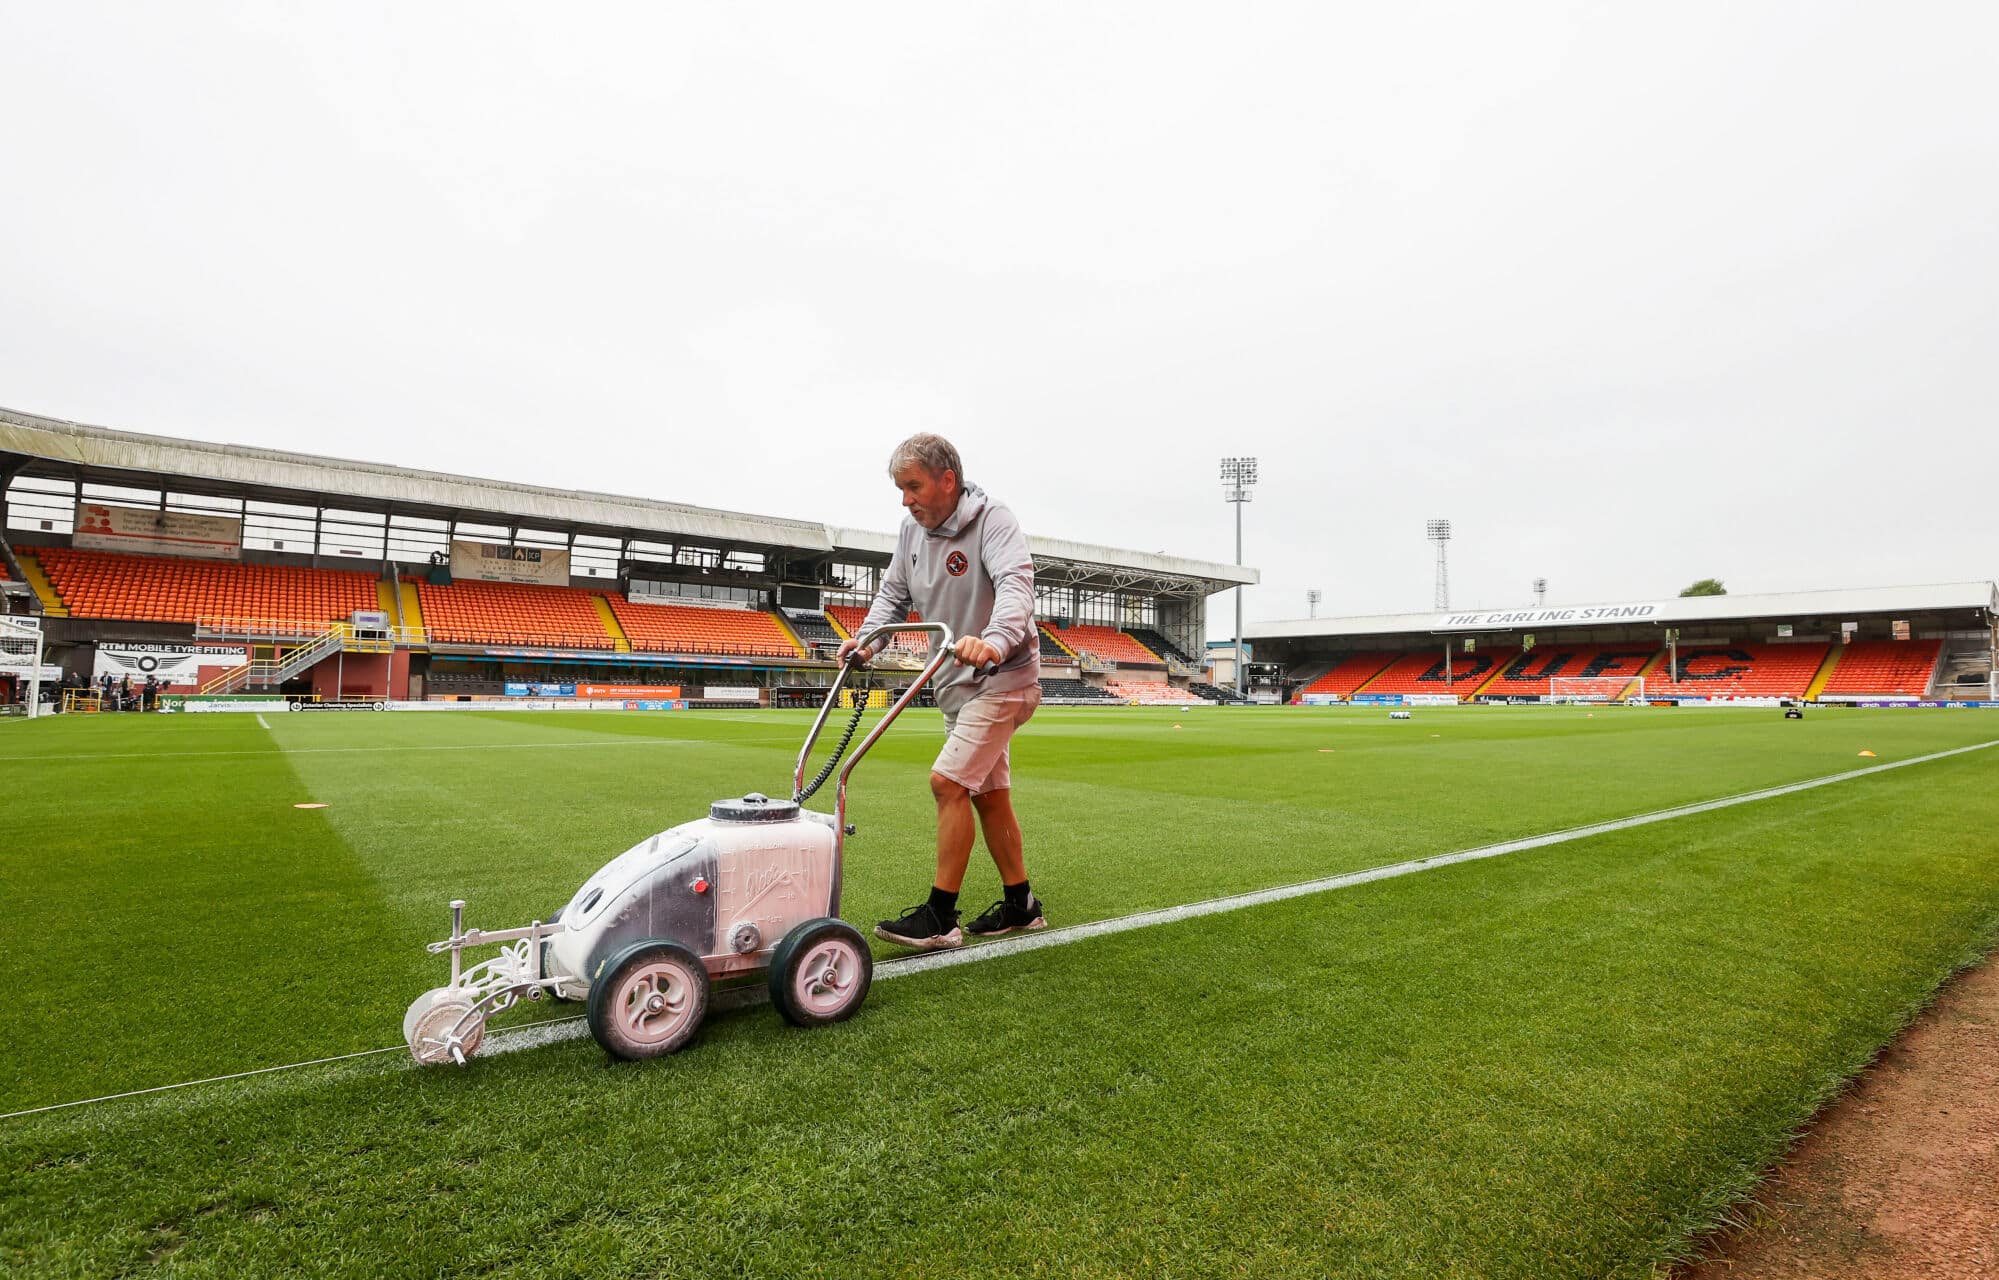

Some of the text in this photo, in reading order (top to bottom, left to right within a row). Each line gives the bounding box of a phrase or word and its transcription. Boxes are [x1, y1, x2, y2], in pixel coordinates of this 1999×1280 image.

[1447, 605, 1656, 625] THE CARLING STAND
[99, 642, 245, 655] RTM MOBILE TYRE FITTING
